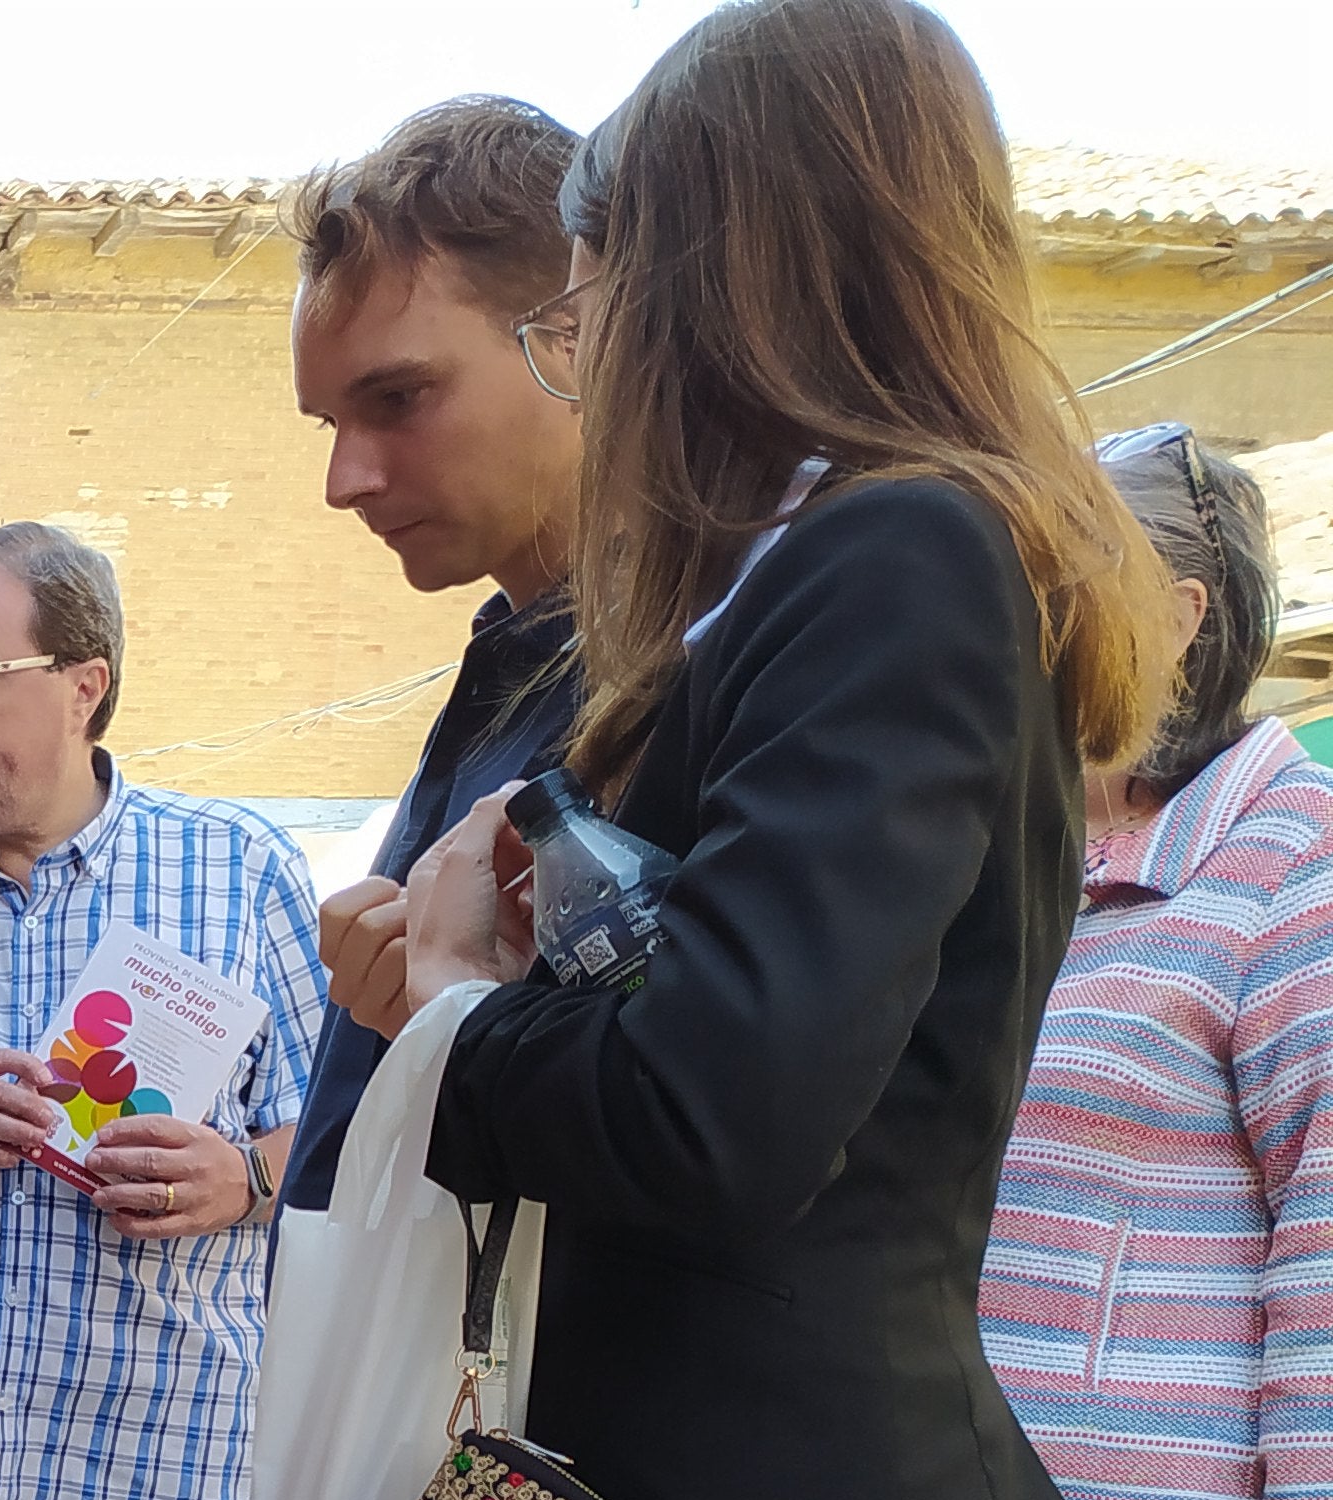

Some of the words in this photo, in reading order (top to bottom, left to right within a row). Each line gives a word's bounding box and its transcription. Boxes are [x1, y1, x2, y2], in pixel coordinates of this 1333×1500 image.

[123, 956, 183, 993] mucho
[184, 989, 217, 1013] que
[133, 943, 179, 972] PROVINCIA
[194, 975, 245, 1008] VALLADOLID
[130, 978, 165, 1002] ver
[165, 999, 227, 1039] contigo
